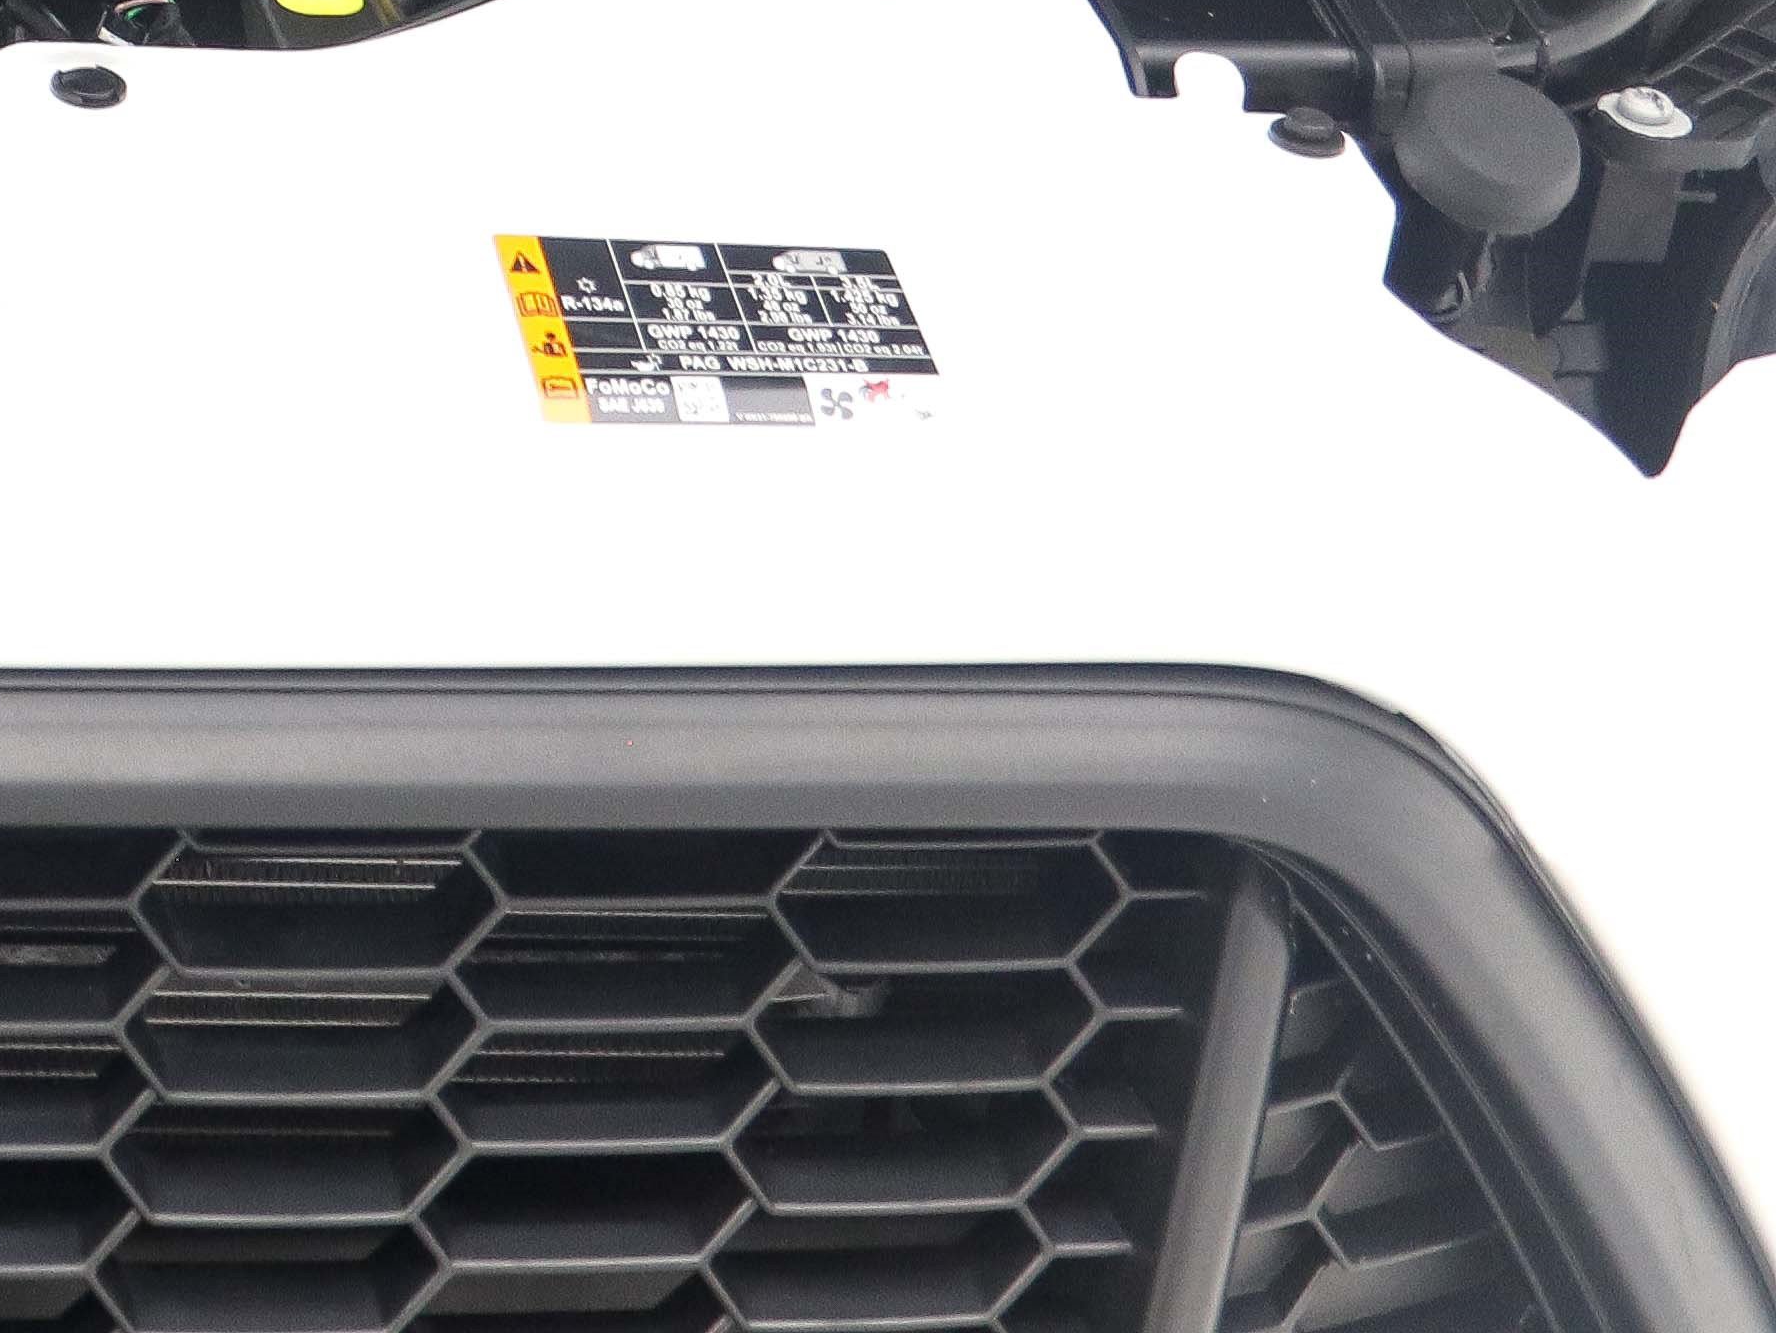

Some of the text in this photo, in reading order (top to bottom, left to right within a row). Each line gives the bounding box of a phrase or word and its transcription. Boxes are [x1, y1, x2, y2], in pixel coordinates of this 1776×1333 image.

[688, 284, 711, 302] kg
[784, 287, 808, 305] kg
[875, 290, 899, 307] kg
[561, 295, 624, 312] R-134a
[648, 324, 740, 341] GWP 1430
[787, 328, 880, 343] GWP 1430
[658, 340, 686, 351] CO2
[688, 341, 707, 353] eq
[757, 341, 785, 352] CO2
[788, 343, 806, 354] eq
[844, 343, 871, 354] CO2
[873, 345, 892, 356] eq
[679, 356, 869, 372] PAG WSH-M1C231-B
[585, 377, 671, 396] FoMoCo
